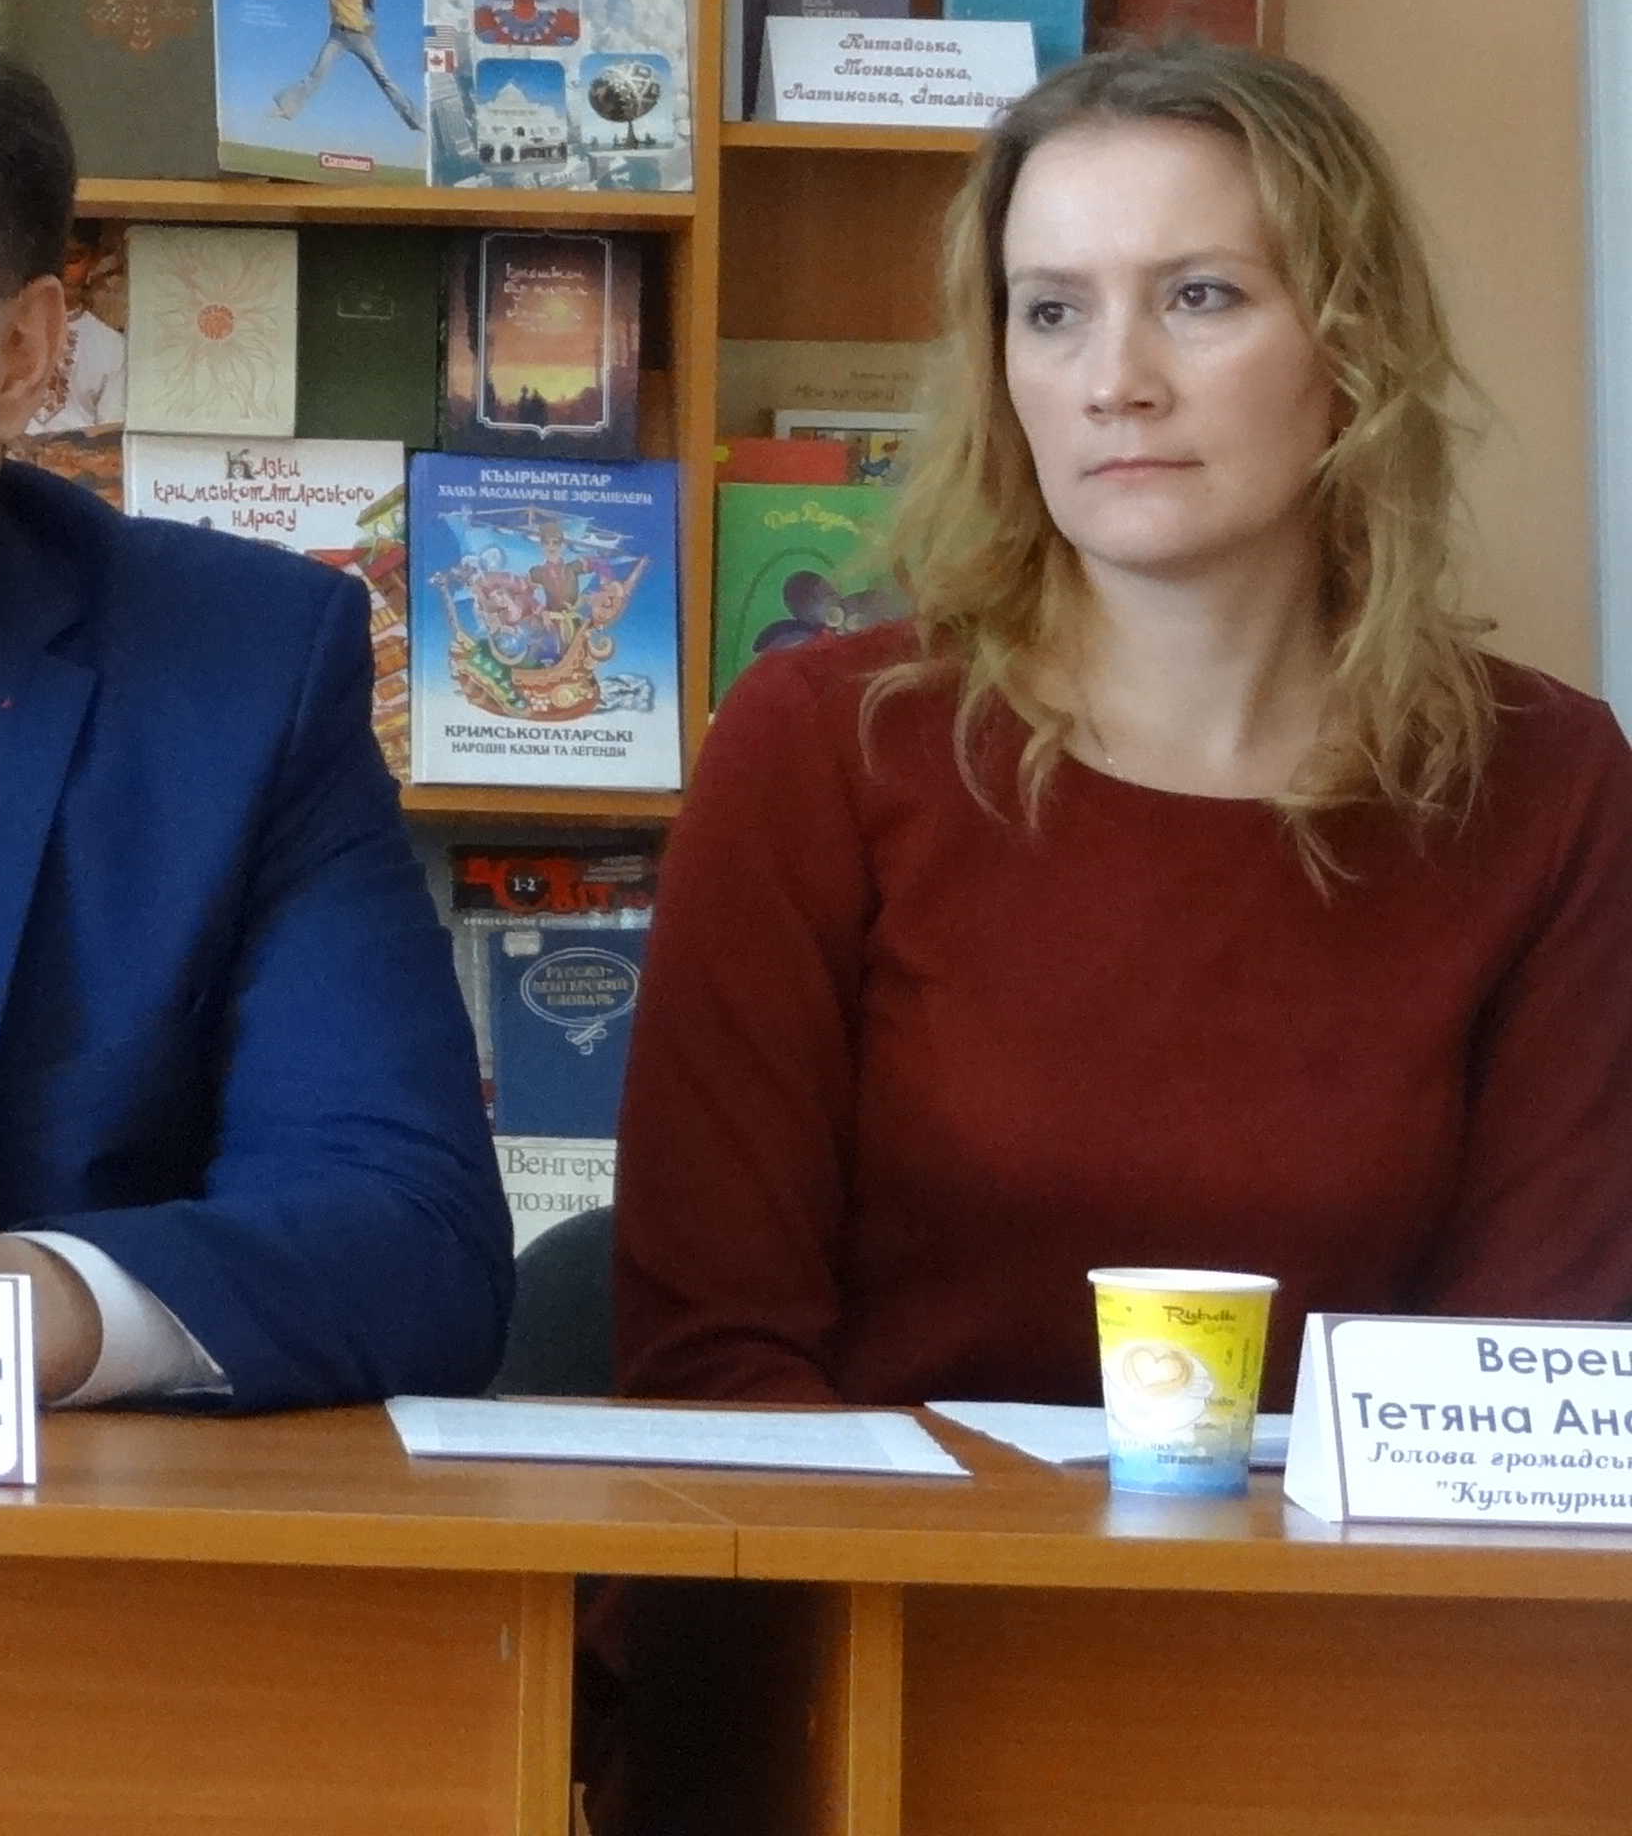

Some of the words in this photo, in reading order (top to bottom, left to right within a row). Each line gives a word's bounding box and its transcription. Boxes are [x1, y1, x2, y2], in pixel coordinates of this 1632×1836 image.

[839, 32, 963, 56] Китайська,
[479, 468, 613, 487] КЪЫРЫМТАТАР
[444, 724, 634, 743] КРИМСЬКОТАТАРСЬКІ
[451, 741, 506, 755] НАРОДНІ
[509, 743, 550, 756] КАЗКИ
[553, 745, 569, 756] ТА
[570, 745, 627, 758] ЛЕГЕНДИ
[512, 876, 537, 893] 1-2
[1352, 1391, 1533, 1436] Тетяна
[1367, 1441, 1477, 1469] Голова
